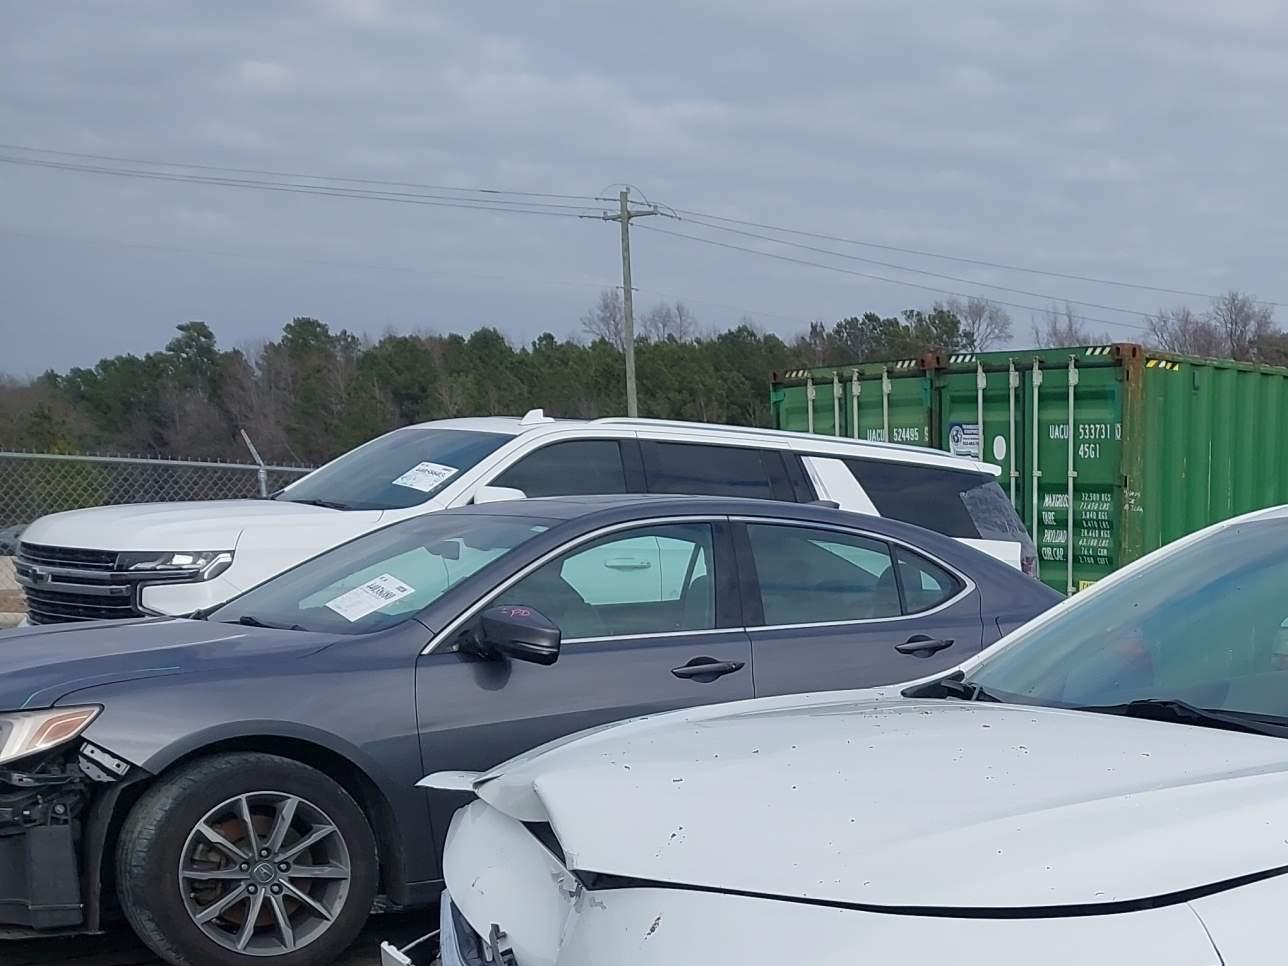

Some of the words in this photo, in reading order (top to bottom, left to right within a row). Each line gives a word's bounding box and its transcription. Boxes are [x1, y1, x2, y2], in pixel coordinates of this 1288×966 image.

[893, 427, 919, 441] 524495
[1049, 424, 1069, 439] UACU
[1079, 424, 1110, 439] 533731
[1078, 443, 1100, 458] 45G1
